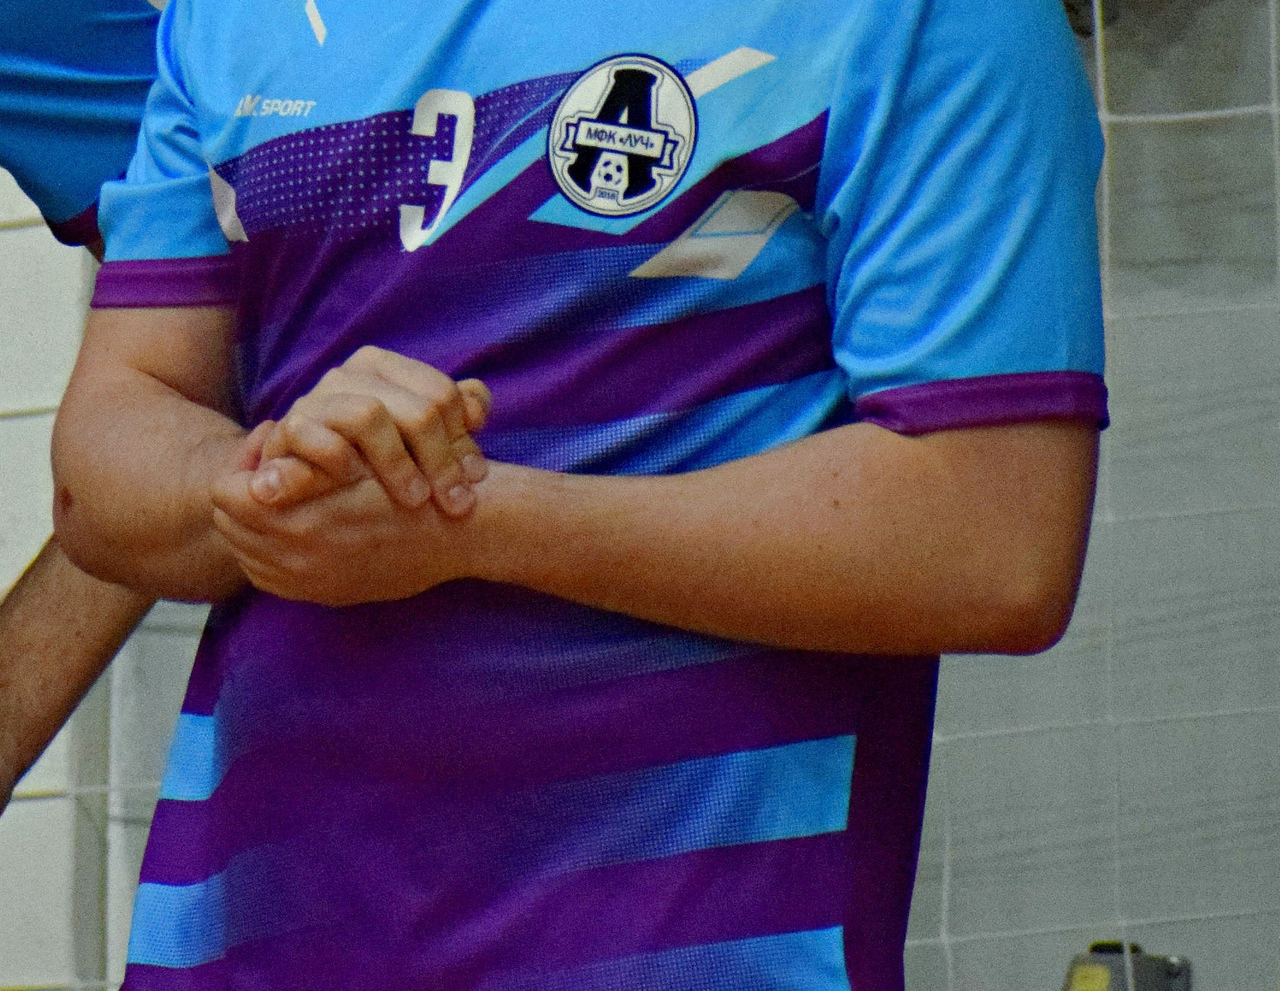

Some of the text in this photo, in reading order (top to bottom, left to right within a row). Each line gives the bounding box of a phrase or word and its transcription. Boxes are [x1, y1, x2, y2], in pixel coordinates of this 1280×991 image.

[260, 99, 317, 116] SPORT
[586, 127, 616, 143] МФК
[399, 89, 476, 252] 3
